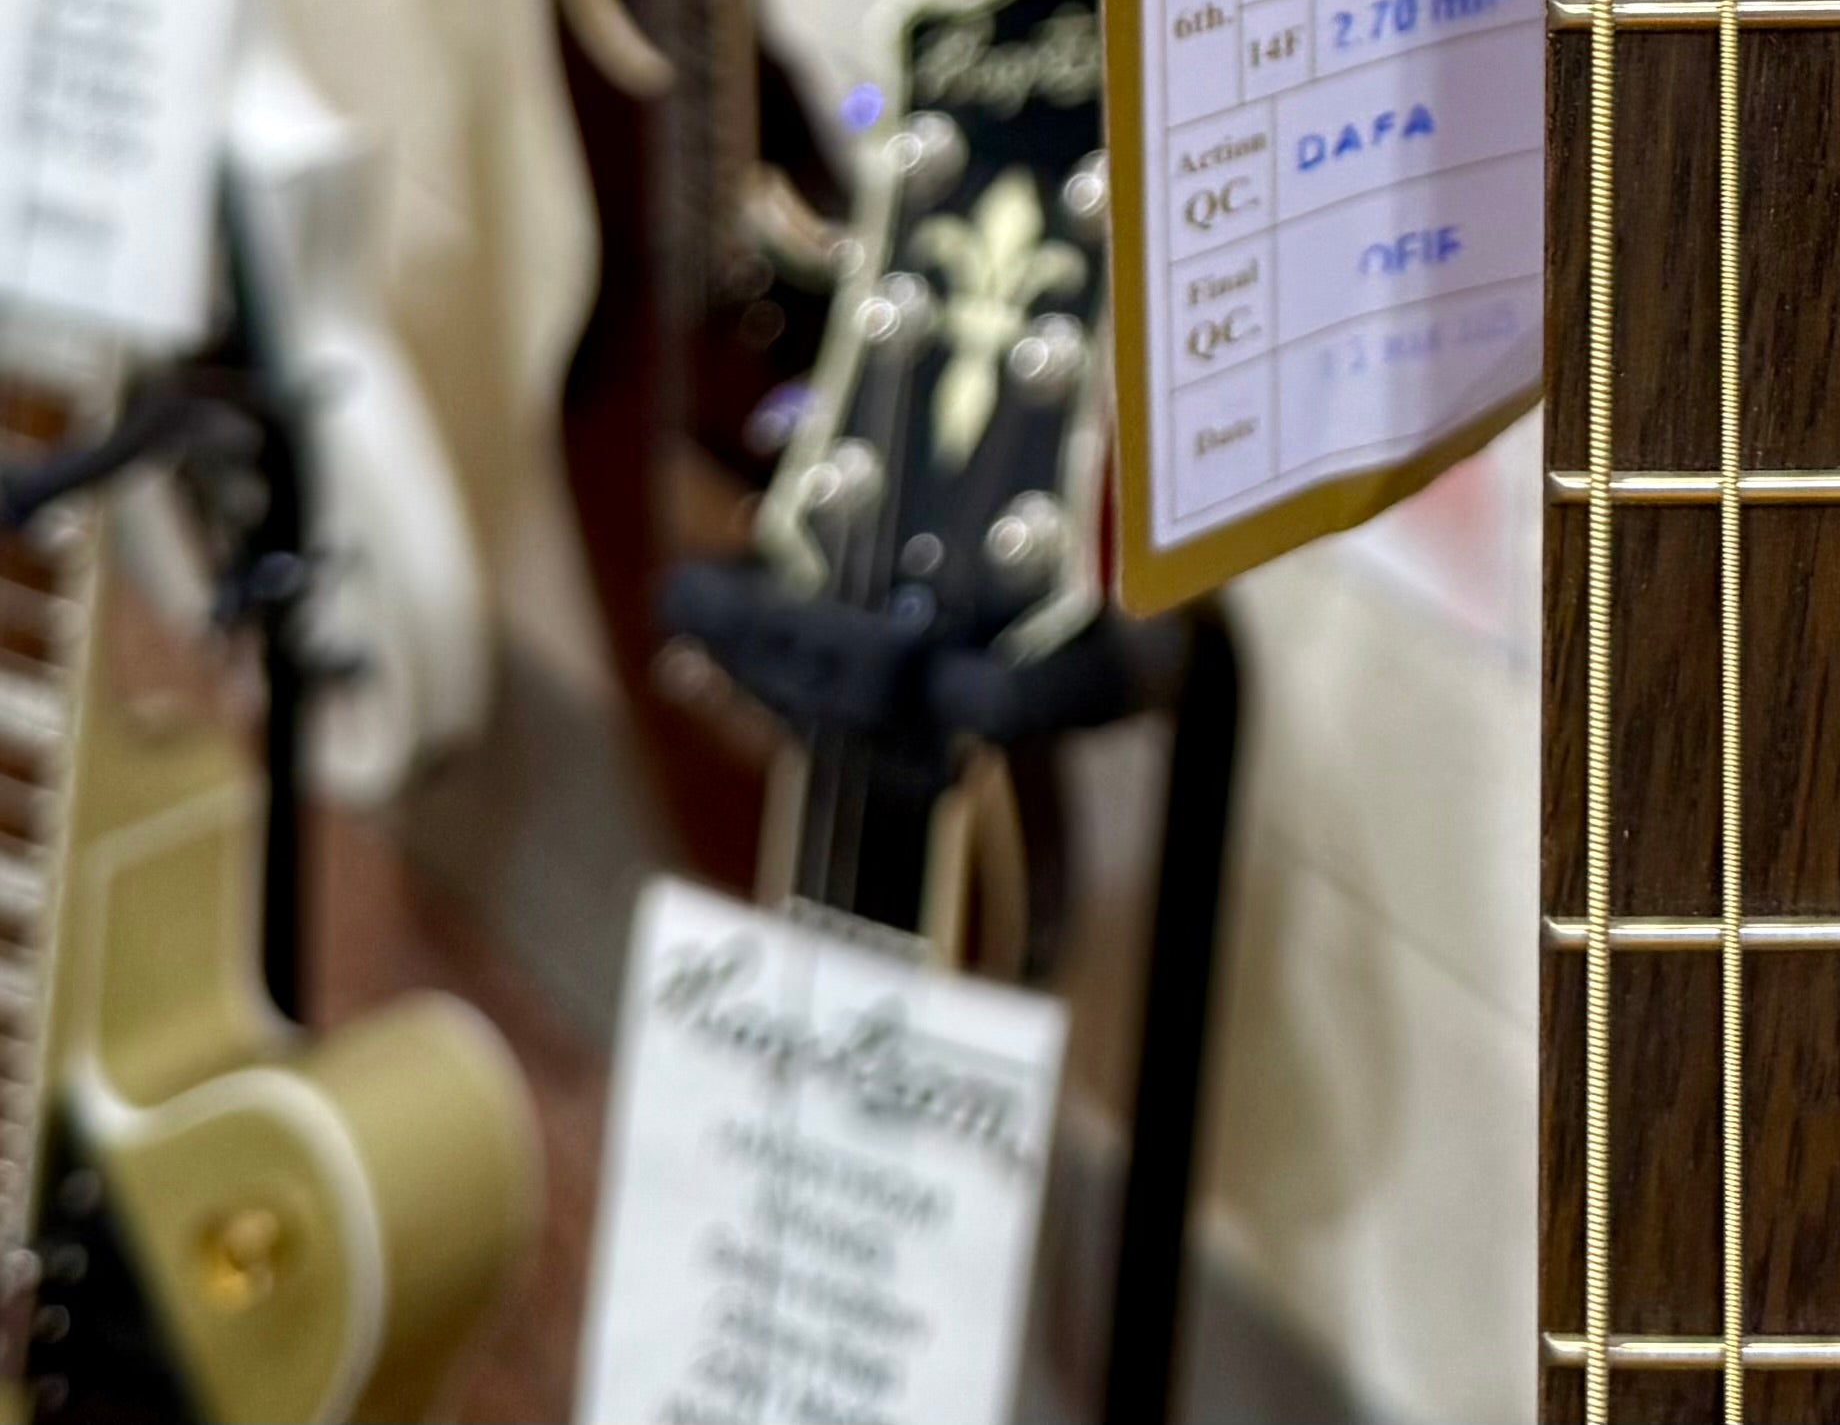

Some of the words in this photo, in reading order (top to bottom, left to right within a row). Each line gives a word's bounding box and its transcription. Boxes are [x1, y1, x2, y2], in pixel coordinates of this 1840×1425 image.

[1250, 26, 1301, 68] 14F
[1179, 132, 1267, 173] Action
[1298, 103, 1437, 172] DAFA
[1187, 256, 1258, 306] Final
